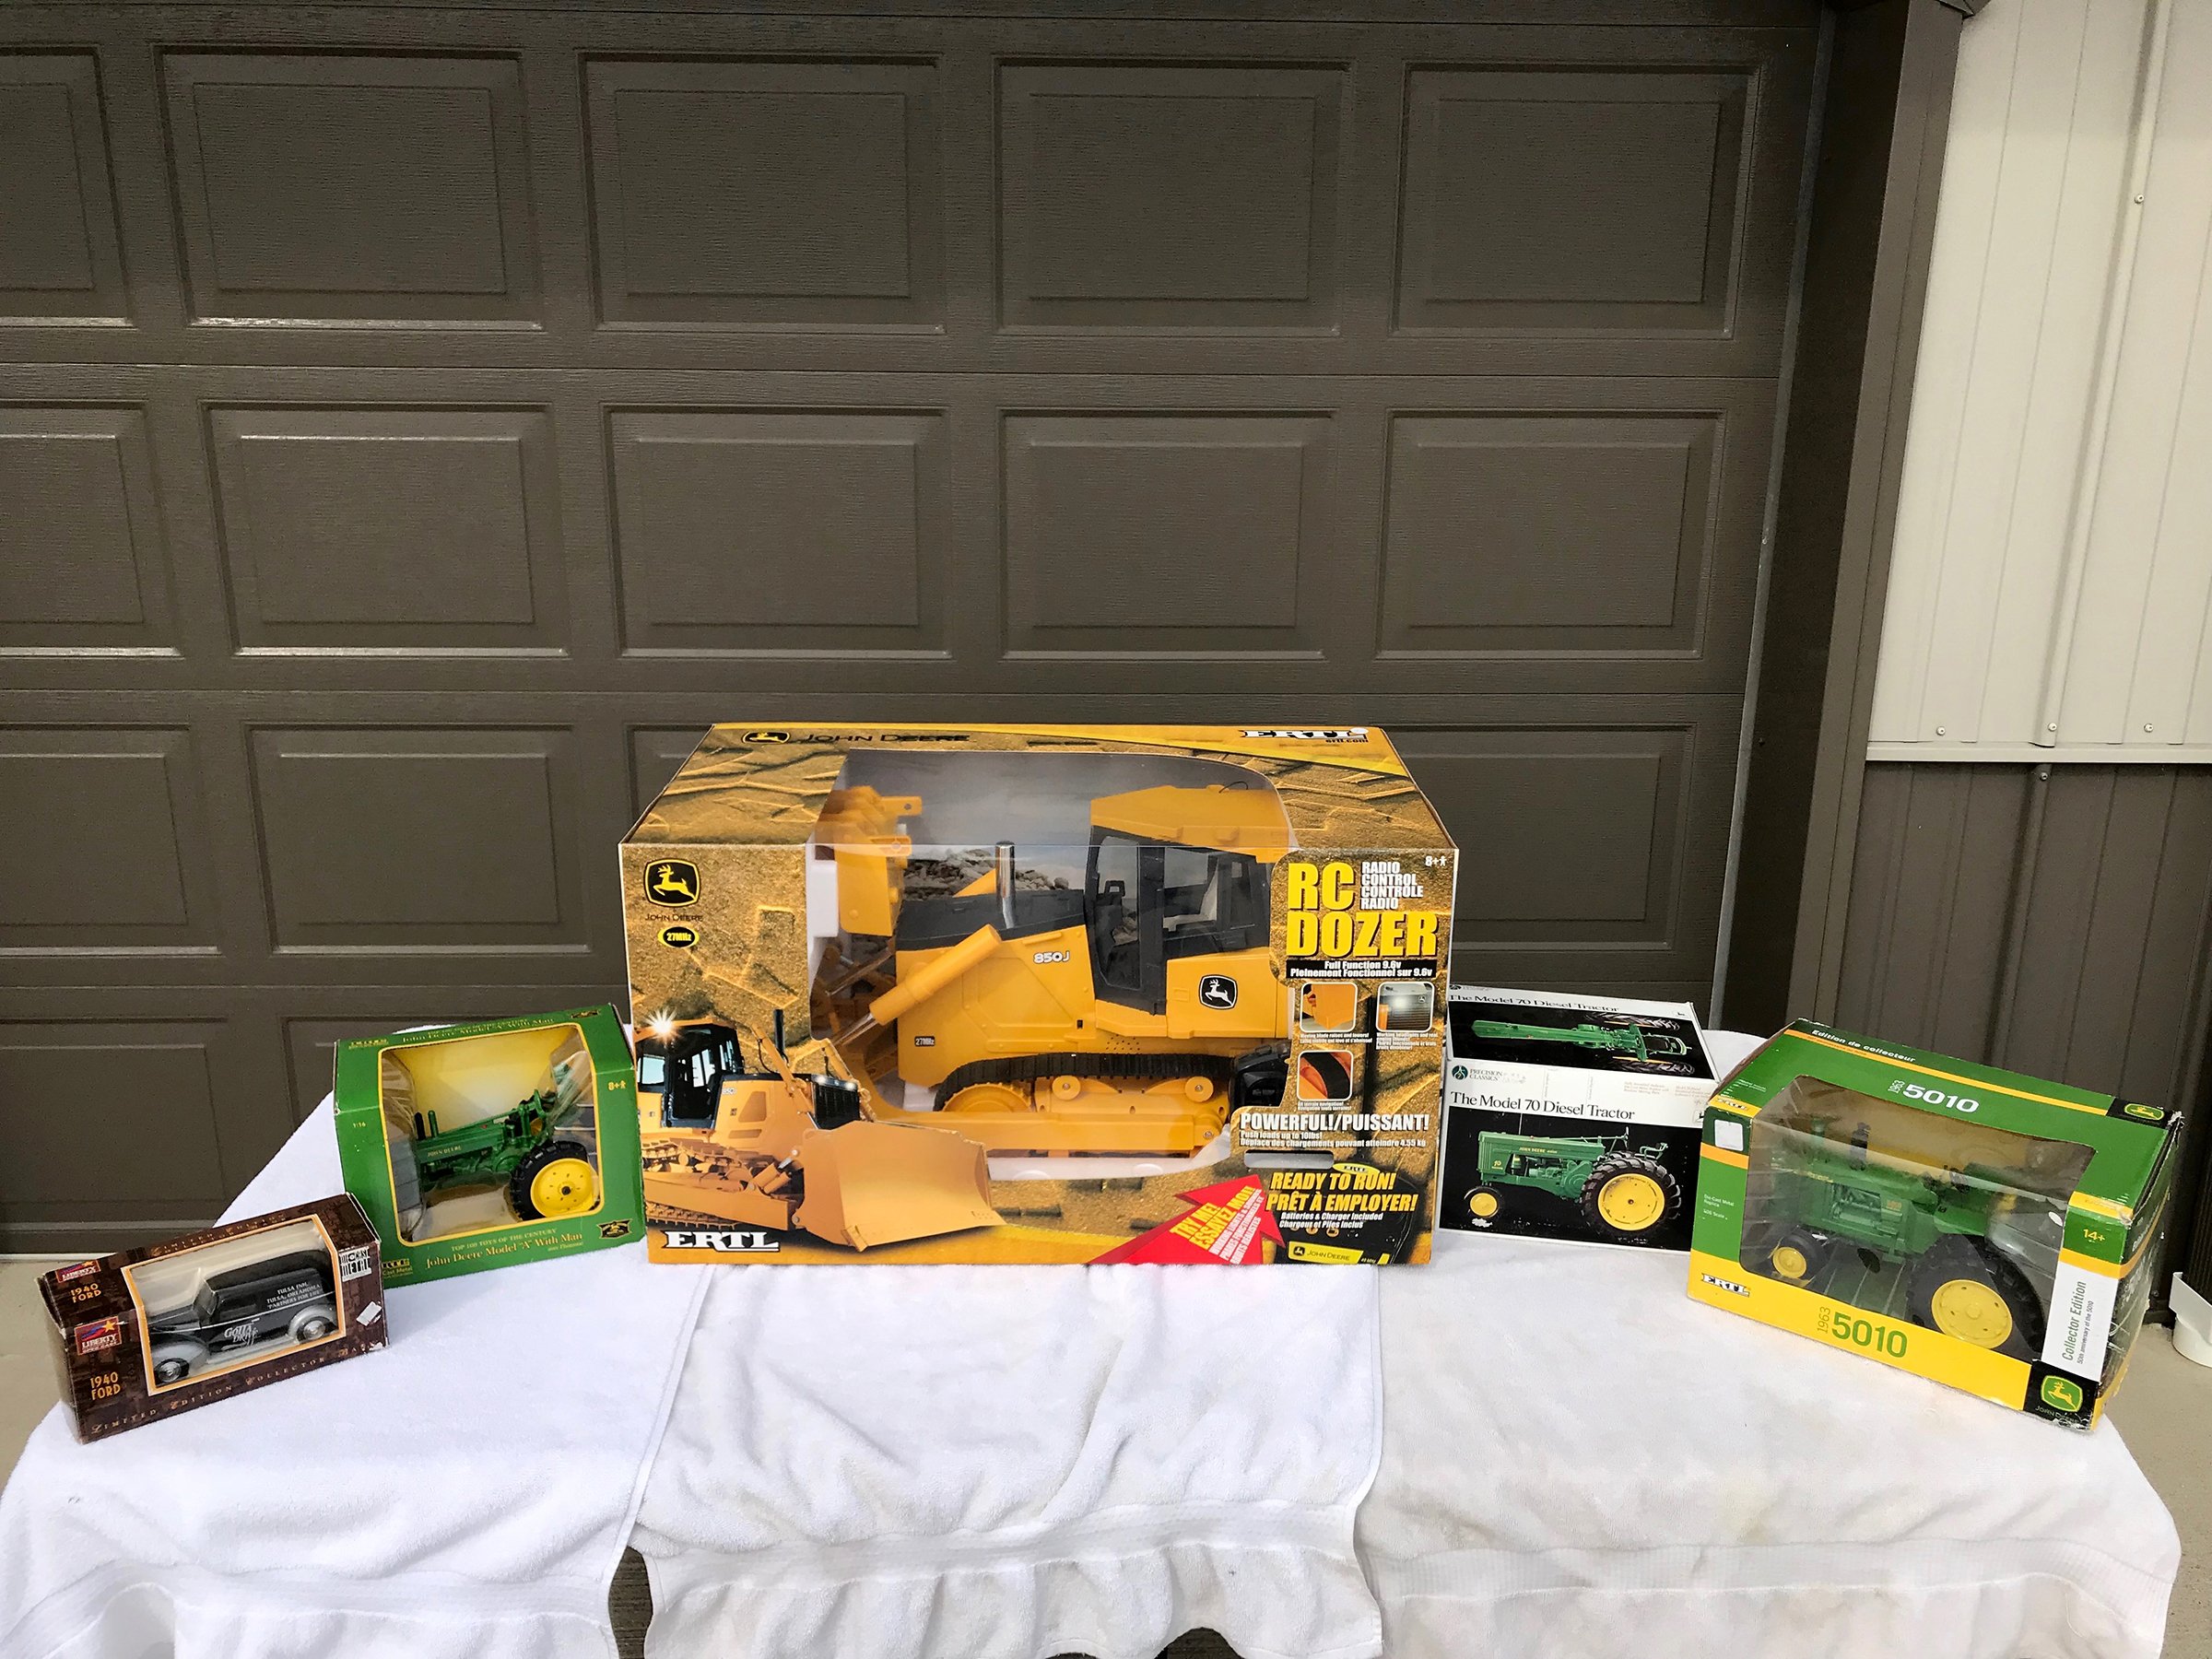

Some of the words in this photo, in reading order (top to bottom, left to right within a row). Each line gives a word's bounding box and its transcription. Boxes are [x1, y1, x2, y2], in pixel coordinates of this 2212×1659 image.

[1361, 862, 1401, 875] RADIO
[1288, 862, 1355, 911] RC
[1361, 874, 1418, 887] CONTROL
[1360, 886, 1424, 898] CONTROLE
[1359, 898, 1399, 911] RADIO
[673, 913, 703, 922] DEERE
[1286, 911, 1439, 958] DOZER
[1033, 950, 1070, 964] 850J
[1324, 960, 1341, 970] Full
[1342, 960, 1381, 970] Function
[1382, 960, 1402, 969] 9.6v
[1290, 968, 1342, 978] Pleinement
[1343, 968, 1396, 977] Fonctionnel
[1413, 968, 1433, 977] 9.6v
[1535, 1000, 1571, 1008] Diesel
[1573, 1002, 1619, 1012] Tractor
[1811, 1029, 1846, 1043] Edition
[1863, 1044, 1916, 1063] collecteur
[1470, 1068, 1503, 1077] PRECISION
[1888, 1079, 1905, 1094] 1963
[1902, 1083, 1980, 1113] 5010
[1450, 1091, 1477, 1106] The
[1479, 1094, 1522, 1110] Model
[1524, 1099, 1540, 1112] 70
[1543, 1100, 1584, 1116] Diesel
[1587, 1104, 1635, 1120] Tractor
[1300, 1132, 1323, 1140] 10lbs!
[1270, 1172, 1327, 1190] READY
[1330, 1172, 1352, 1190] TO
[1353, 1172, 1396, 1190] RUN!
[1265, 1191, 1310, 1211] PRÊT
[1310, 1191, 1322, 1211] À
[1324, 1194, 1418, 1212] EMPLOYER!
[1169, 1217, 1204, 1240] TRY
[1191, 1202, 1222, 1224] ME!
[1280, 1212, 1314, 1220] Batteries
[1321, 1213, 1350, 1221] Charger
[1189, 1206, 1238, 1251] ESSAYEZ
[1279, 1220, 1312, 1230] Chargeur
[451, 1243, 465, 1252] TOP
[524, 1228, 558, 1238] CENTURY
[663, 1230, 780, 1252] ERTL
[2083, 1229, 2106, 1241] 14+
[427, 1256, 451, 1269] John
[453, 1251, 483, 1263] Deere
[486, 1242, 517, 1256] Model
[535, 1235, 559, 1246] With
[560, 1232, 582, 1243] Man
[1307, 1249, 1327, 1258] JOHN
[1327, 1252, 1350, 1262] DEERE
[62, 1266, 97, 1279] LIBERTY
[70, 1283, 99, 1297] 1940
[277, 1285, 295, 1295] TULSA
[1701, 1273, 1750, 1298] ERTL
[72, 1289, 101, 1303] FORD
[266, 1293, 287, 1304] TULSA,
[288, 1284, 321, 1298] OKLAHOMA
[2070, 1281, 2087, 1316] Edition
[81, 1333, 118, 1348] LIBERTY
[1817, 1306, 1831, 1334] 1963
[1831, 1311, 1908, 1359] 5010
[2062, 1316, 2080, 1361] Collector
[2080, 1327, 2090, 1353] anniversary
[89, 1371, 119, 1389] 1940
[90, 1383, 122, 1401] FORD
[91, 1408, 158, 1434] LIMITED
[169, 1385, 232, 1410] EDITION
[245, 1357, 325, 1385] COLLECTOR
[2035, 1405, 2055, 1417] JOHN
